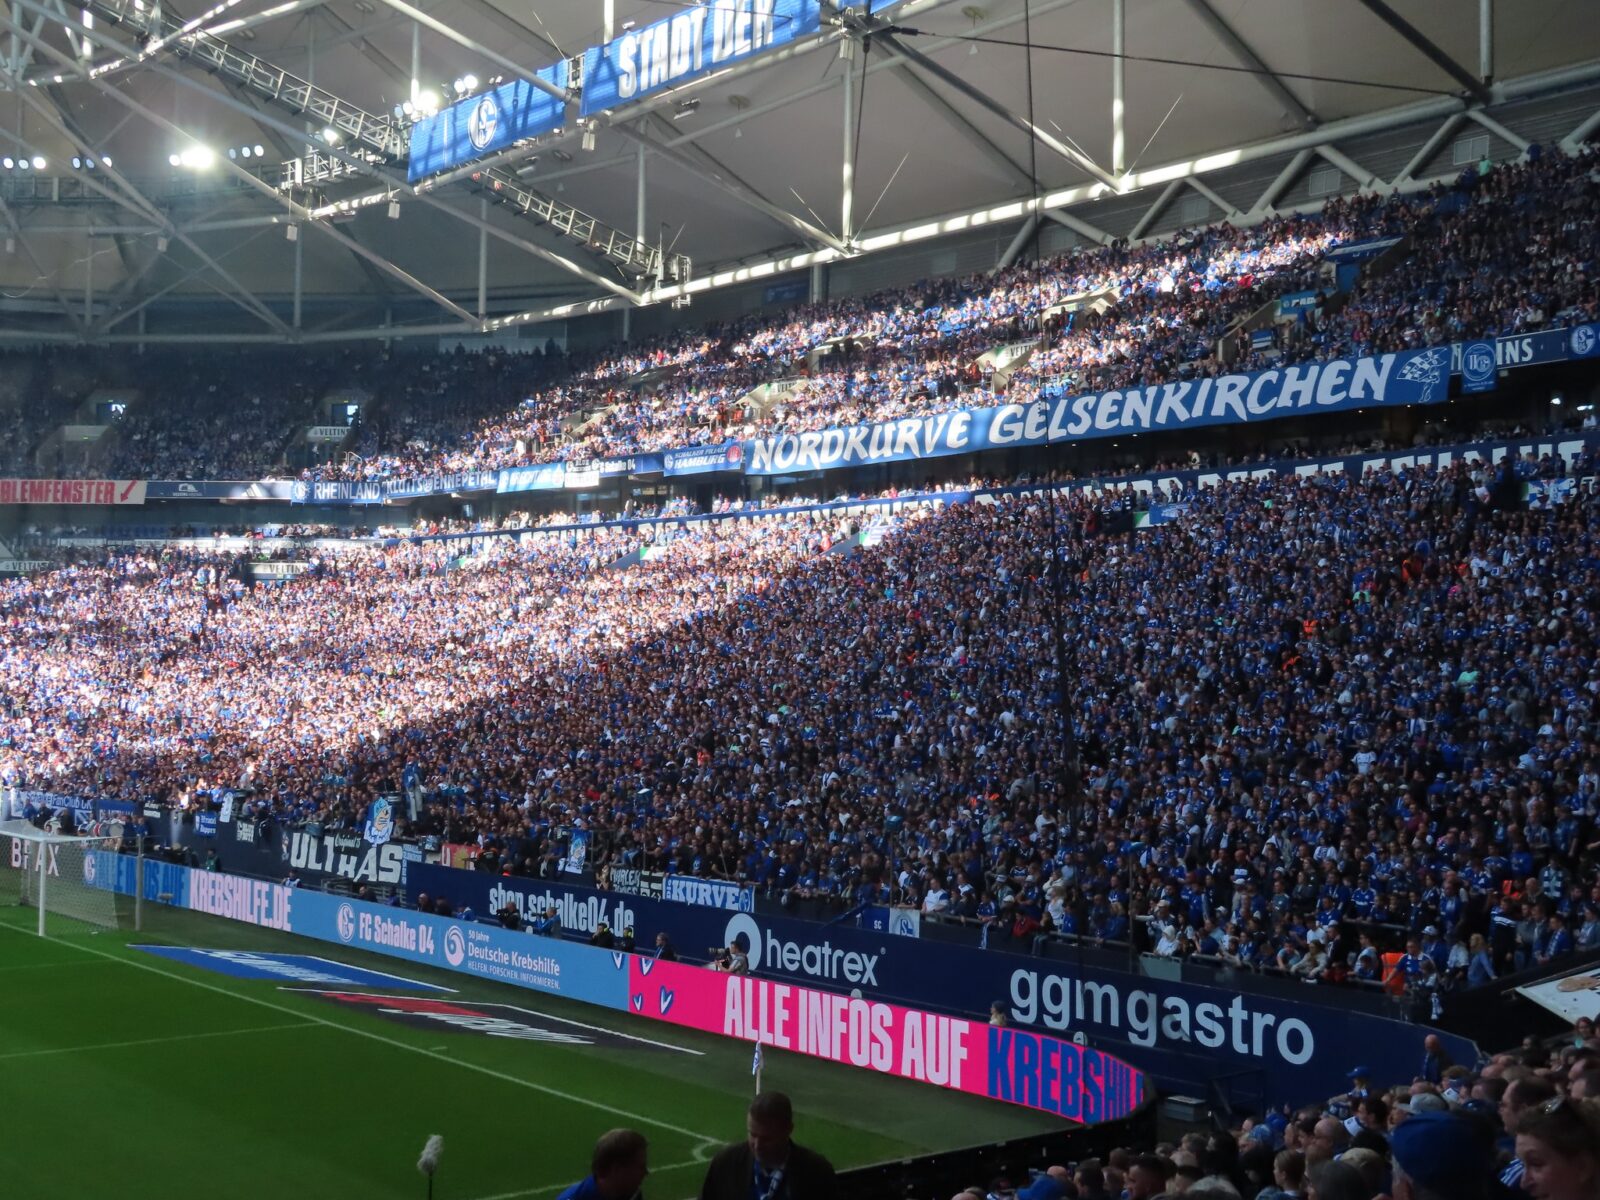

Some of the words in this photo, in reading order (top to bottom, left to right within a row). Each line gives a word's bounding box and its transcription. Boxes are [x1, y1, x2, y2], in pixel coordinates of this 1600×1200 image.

[618, 7, 708, 98] STADT
[713, 0, 774, 63] DER
[752, 411, 969, 472] NORDKURVE
[989, 354, 1397, 446] GELSENKIRCHEN
[674, 454, 726, 469] HAMBURG
[314, 481, 380, 500] RHEINLAND
[434, 470, 497, 490] ENNEPETAL
[269, 564, 301, 574] VELTIN
[126, 857, 159, 901] INOS
[290, 833, 403, 884] ULTRAS
[189, 868, 293, 932] KREBSHILFE.DE
[672, 880, 740, 912] KURVE
[360, 912, 372, 940] FC
[374, 914, 417, 951] Schalke
[419, 923, 435, 955] 04
[468, 929, 475, 940] 50
[475, 930, 490, 942] Jahre
[468, 941, 509, 966] Deutsche
[511, 951, 560, 977] Krebshilfe
[468, 960, 489, 974] HELFEN.
[520, 971, 561, 990] INFORMIEREN.
[765, 929, 879, 988] heatrex
[724, 974, 790, 1049] ALLE
[799, 989, 893, 1073] INFOS
[901, 1009, 970, 1089] AUF
[1010, 967, 1314, 1066] ggmgastro
